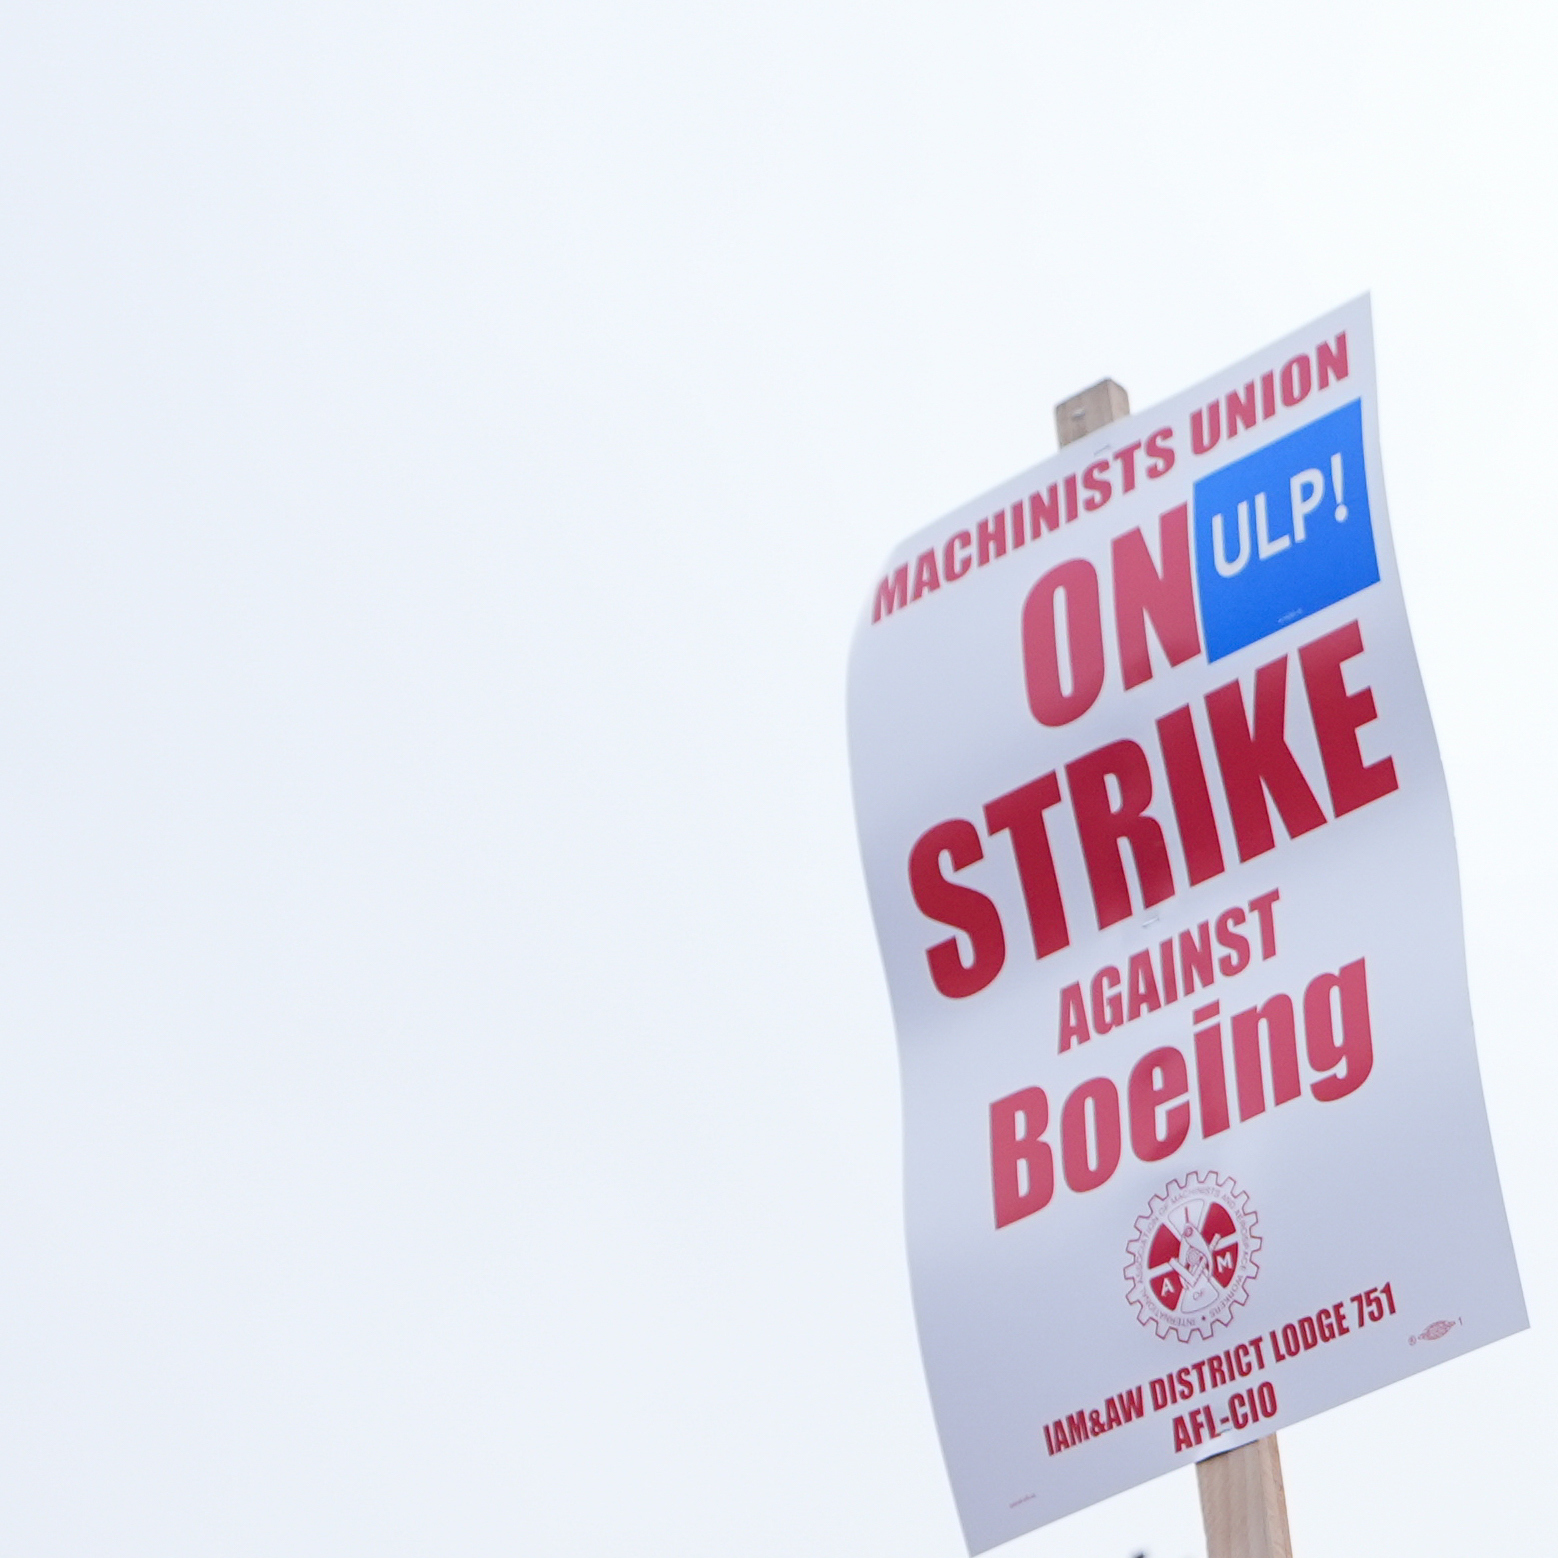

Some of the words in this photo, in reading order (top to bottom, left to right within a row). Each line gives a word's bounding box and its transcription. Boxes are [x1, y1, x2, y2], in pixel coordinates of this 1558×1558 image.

[871, 427, 1176, 625] MACHINISTS
[1189, 329, 1350, 457] UNION
[1020, 501, 1202, 728] ON
[1211, 454, 1350, 578] ULP!
[907, 619, 1399, 999] STRIKE
[989, 957, 1374, 1231] Boeing
[1057, 887, 1280, 1055] AGAINST
[1043, 1385, 1145, 1456] IAM&AW
[1150, 1336, 1266, 1412] DISTRICT
[1272, 1296, 1350, 1364] LODGE
[1352, 1281, 1397, 1328] 751
[1171, 1380, 1278, 1453] AFL-CIO
